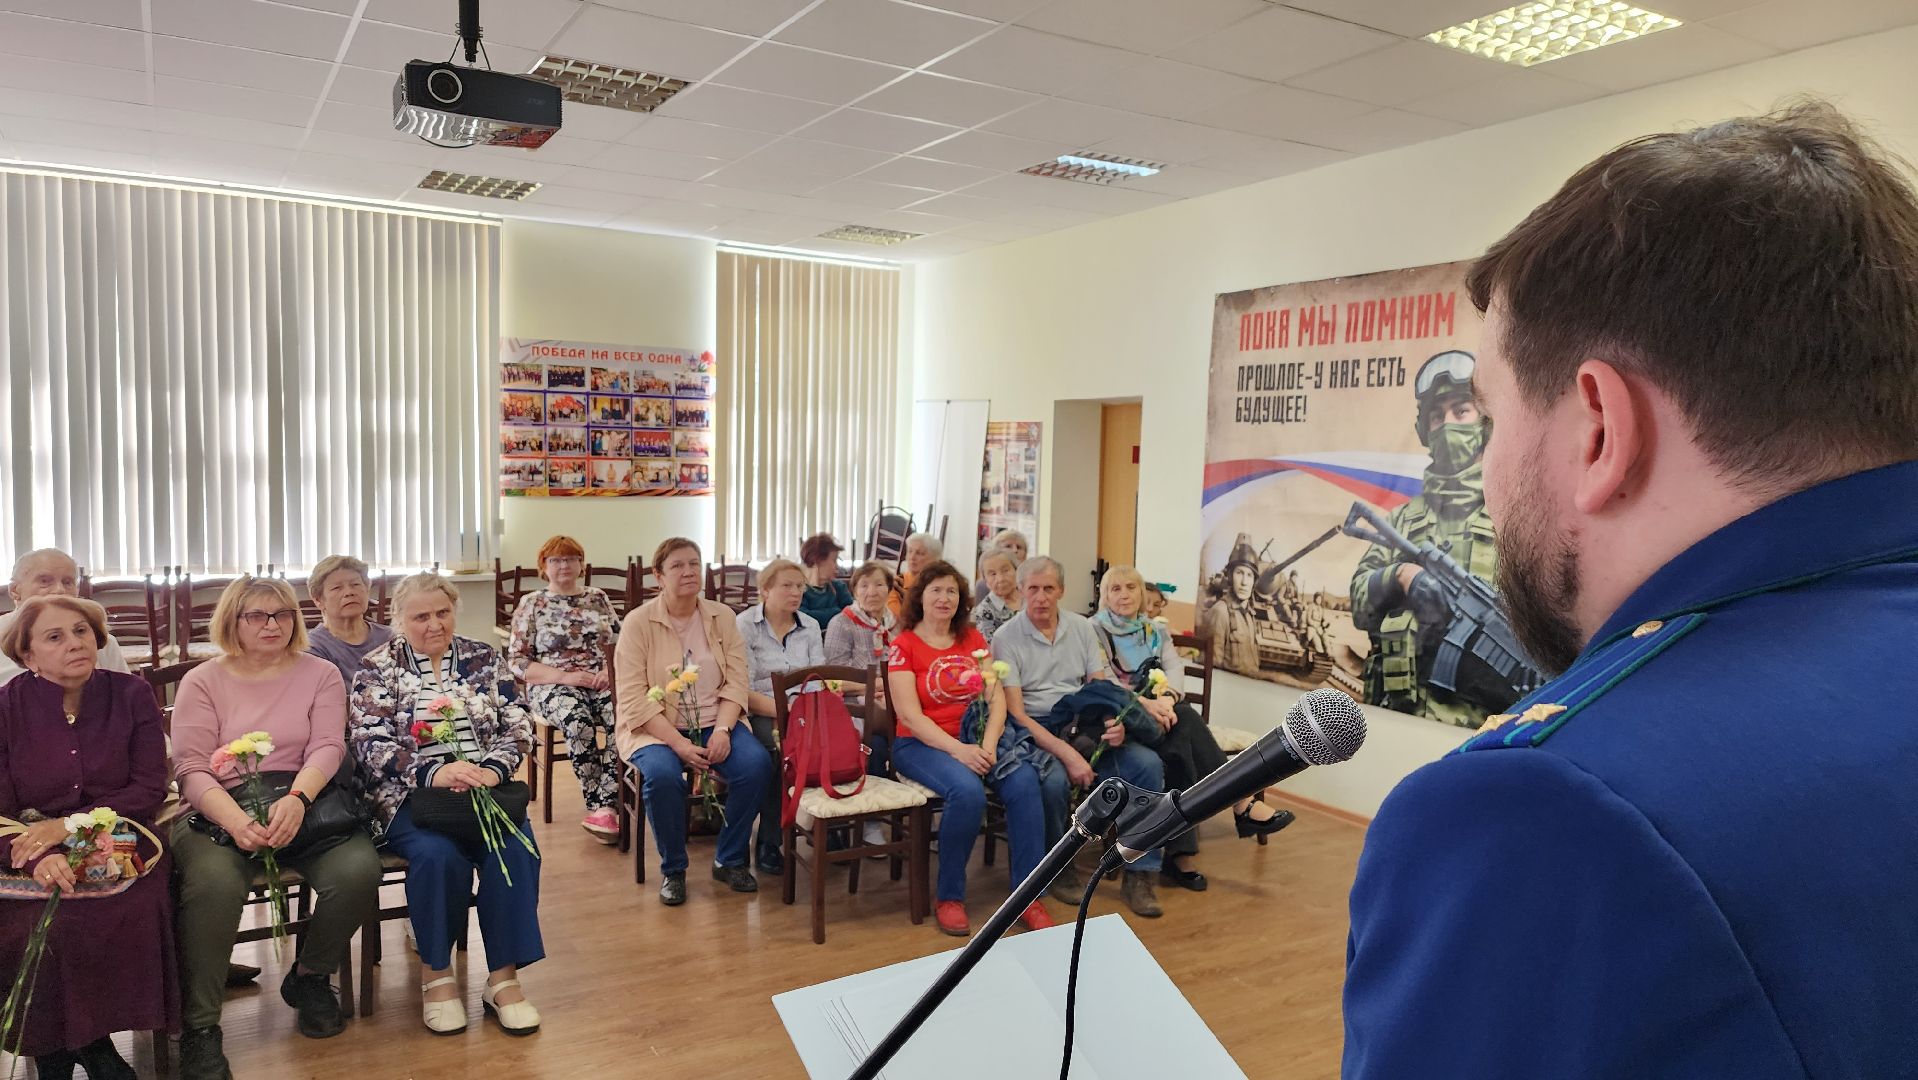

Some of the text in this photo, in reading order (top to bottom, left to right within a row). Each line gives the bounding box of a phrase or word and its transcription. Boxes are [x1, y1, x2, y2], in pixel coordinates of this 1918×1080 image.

[1239, 292, 1456, 351] ПОКА МЫ ПОМНИМ
[531, 346, 683, 364] ПОБЕДА НА ВСЕХ ОДНА
[1329, 359, 1360, 388] НАС
[1366, 356, 1406, 387] ЕСТЬ
[1235, 395, 1308, 424] БУДУЩЕЕ!
